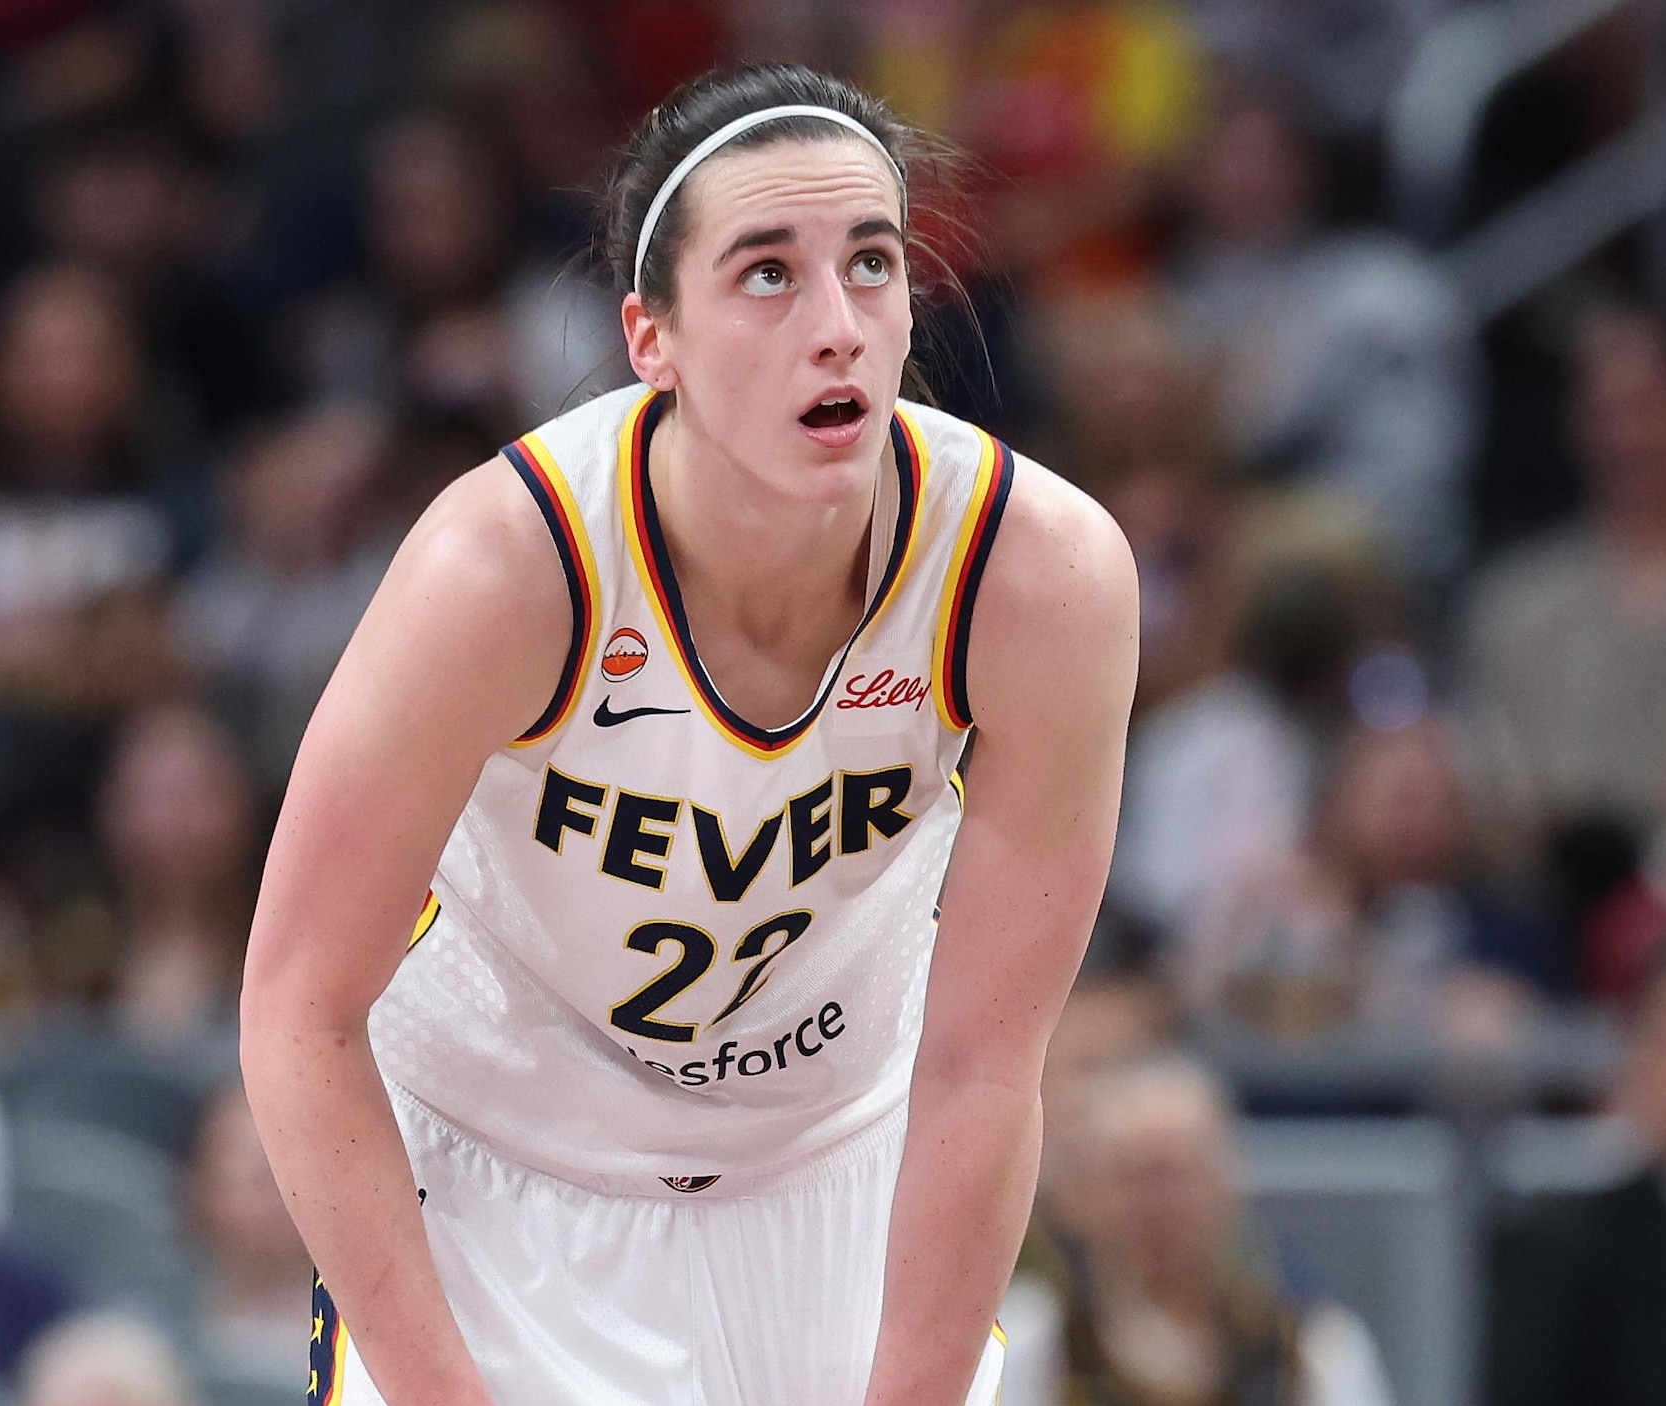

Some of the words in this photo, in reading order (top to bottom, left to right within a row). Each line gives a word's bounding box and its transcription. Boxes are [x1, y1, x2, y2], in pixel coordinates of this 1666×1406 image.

[837, 669, 932, 712] Lilly
[533, 762, 916, 903] FEVER
[608, 908, 816, 1043] 22
[627, 1001, 845, 1085] esforce
